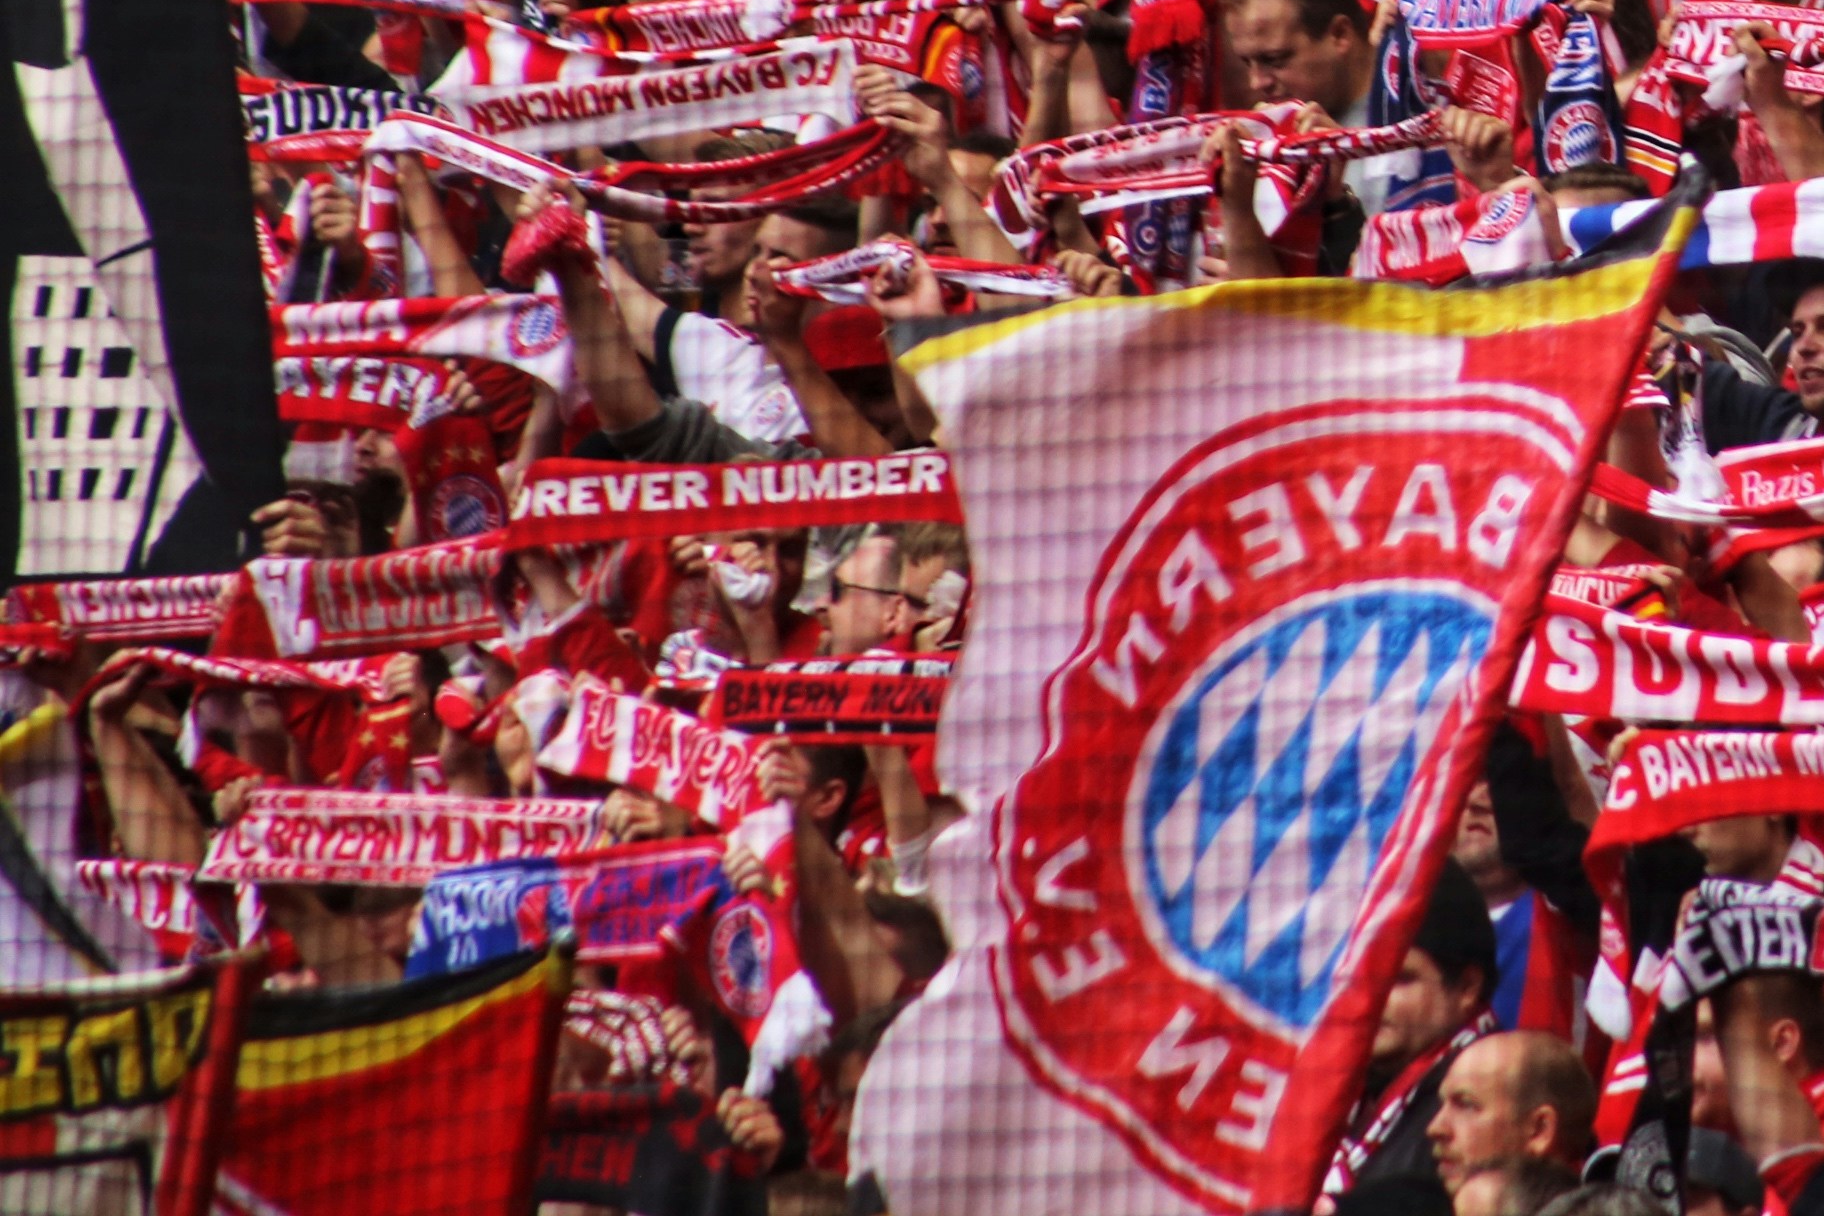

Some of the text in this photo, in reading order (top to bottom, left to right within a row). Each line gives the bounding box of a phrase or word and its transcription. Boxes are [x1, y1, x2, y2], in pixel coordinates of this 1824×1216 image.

[470, 44, 840, 136] FC BAYERN MÜNCHEN
[720, 453, 948, 510] NUMBER
[723, 670, 851, 719] BAYERN
[1638, 732, 1784, 801] BAYERN
